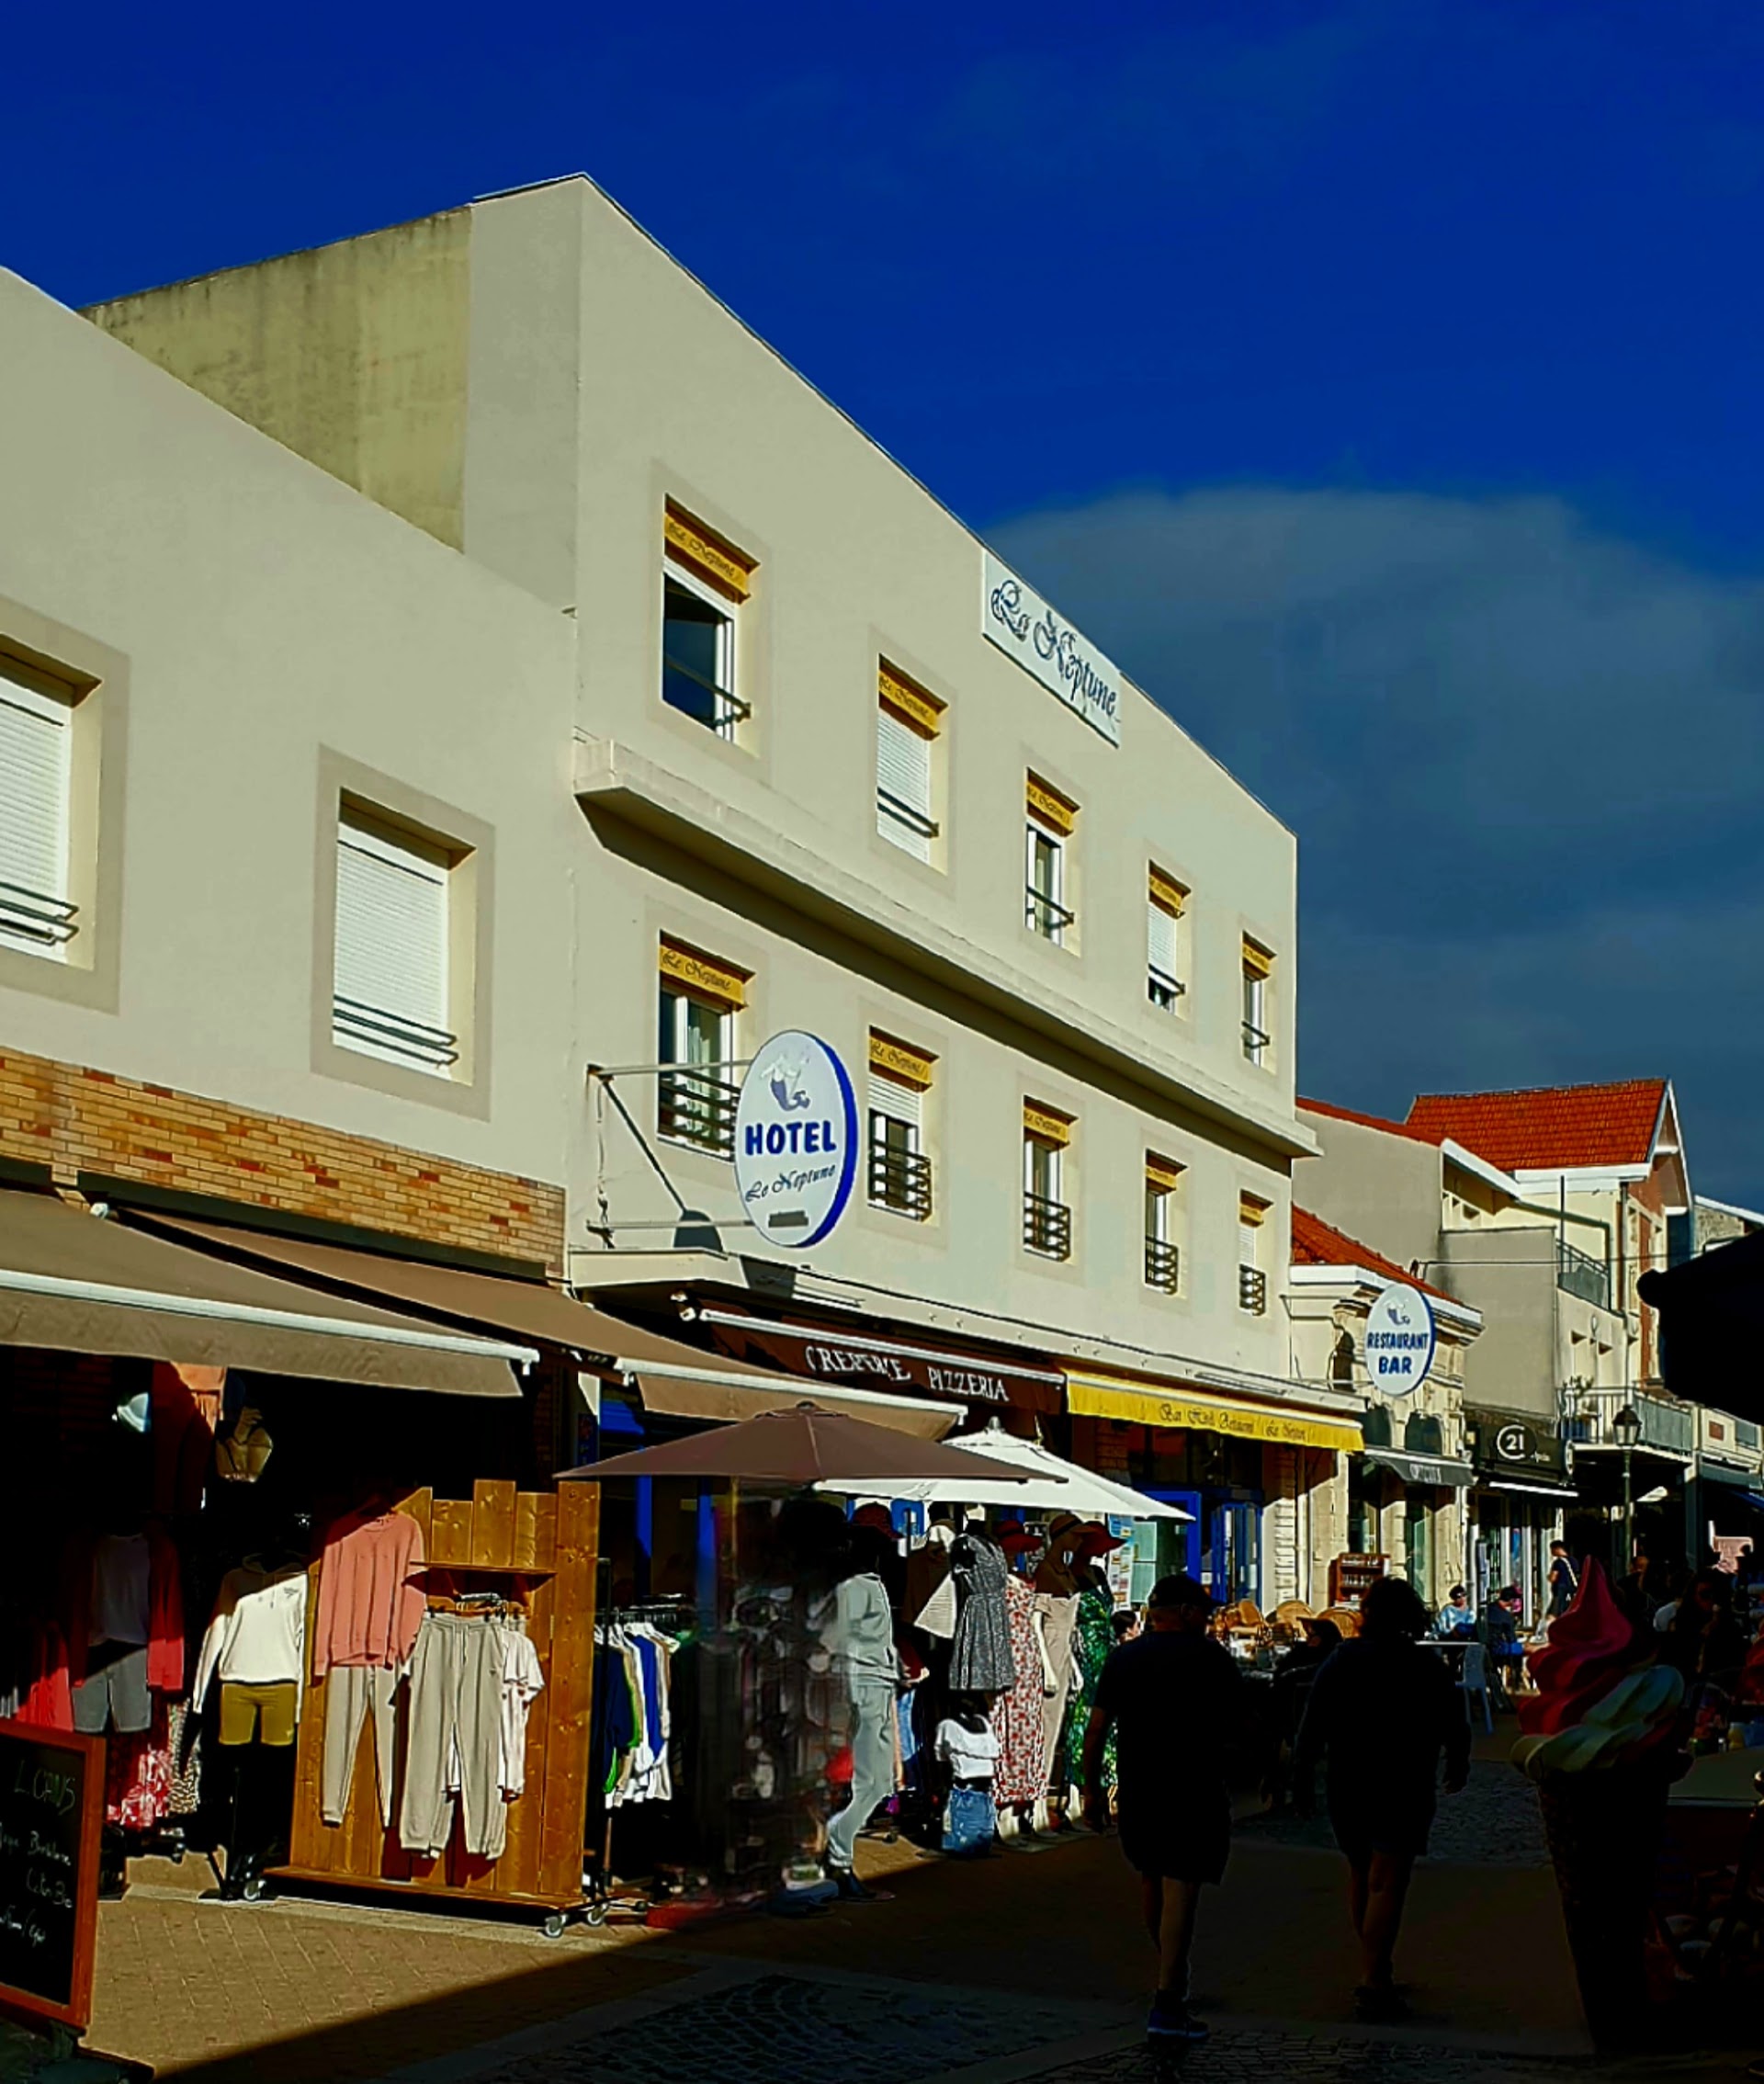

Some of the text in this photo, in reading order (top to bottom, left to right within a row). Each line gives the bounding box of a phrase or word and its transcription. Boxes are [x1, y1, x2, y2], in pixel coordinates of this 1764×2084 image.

[990, 579, 1118, 717] Le Neptune
[745, 1120, 837, 1156] HOTEL
[744, 1164, 836, 1203] Le Neptune
[1367, 1331, 1429, 1350] RESTAURANT
[926, 1365, 1009, 1401] PIZZERIA
[1378, 1355, 1412, 1375] BAR
